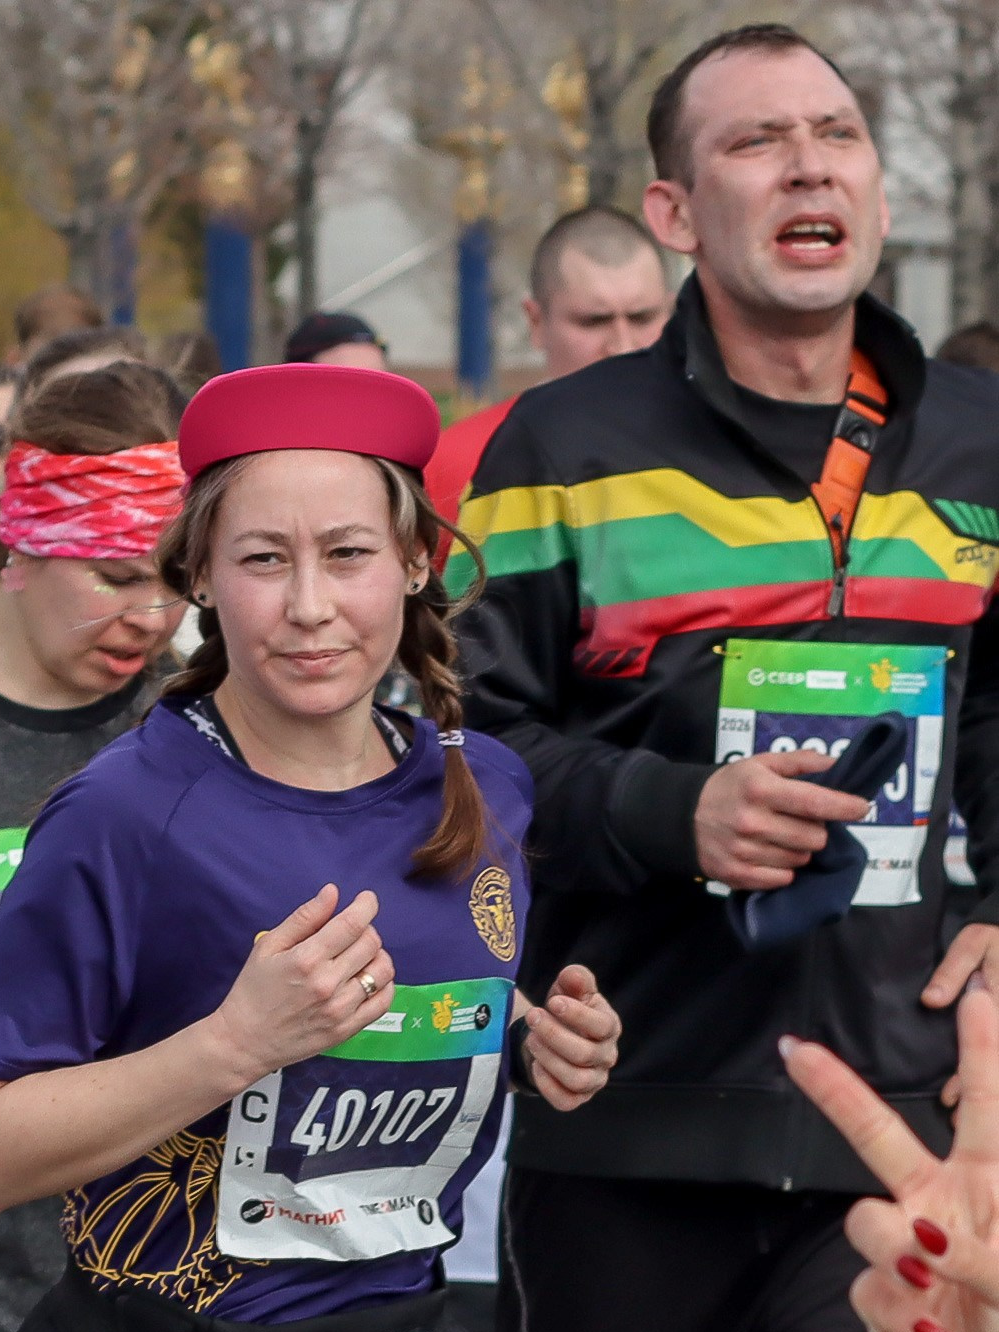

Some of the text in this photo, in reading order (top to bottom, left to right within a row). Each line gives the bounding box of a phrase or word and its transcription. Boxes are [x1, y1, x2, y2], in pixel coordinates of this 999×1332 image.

[240, 1091, 269, 1123] C
[290, 1086, 458, 1157] 40107
[278, 1207, 347, 1227] МАГНИТ
